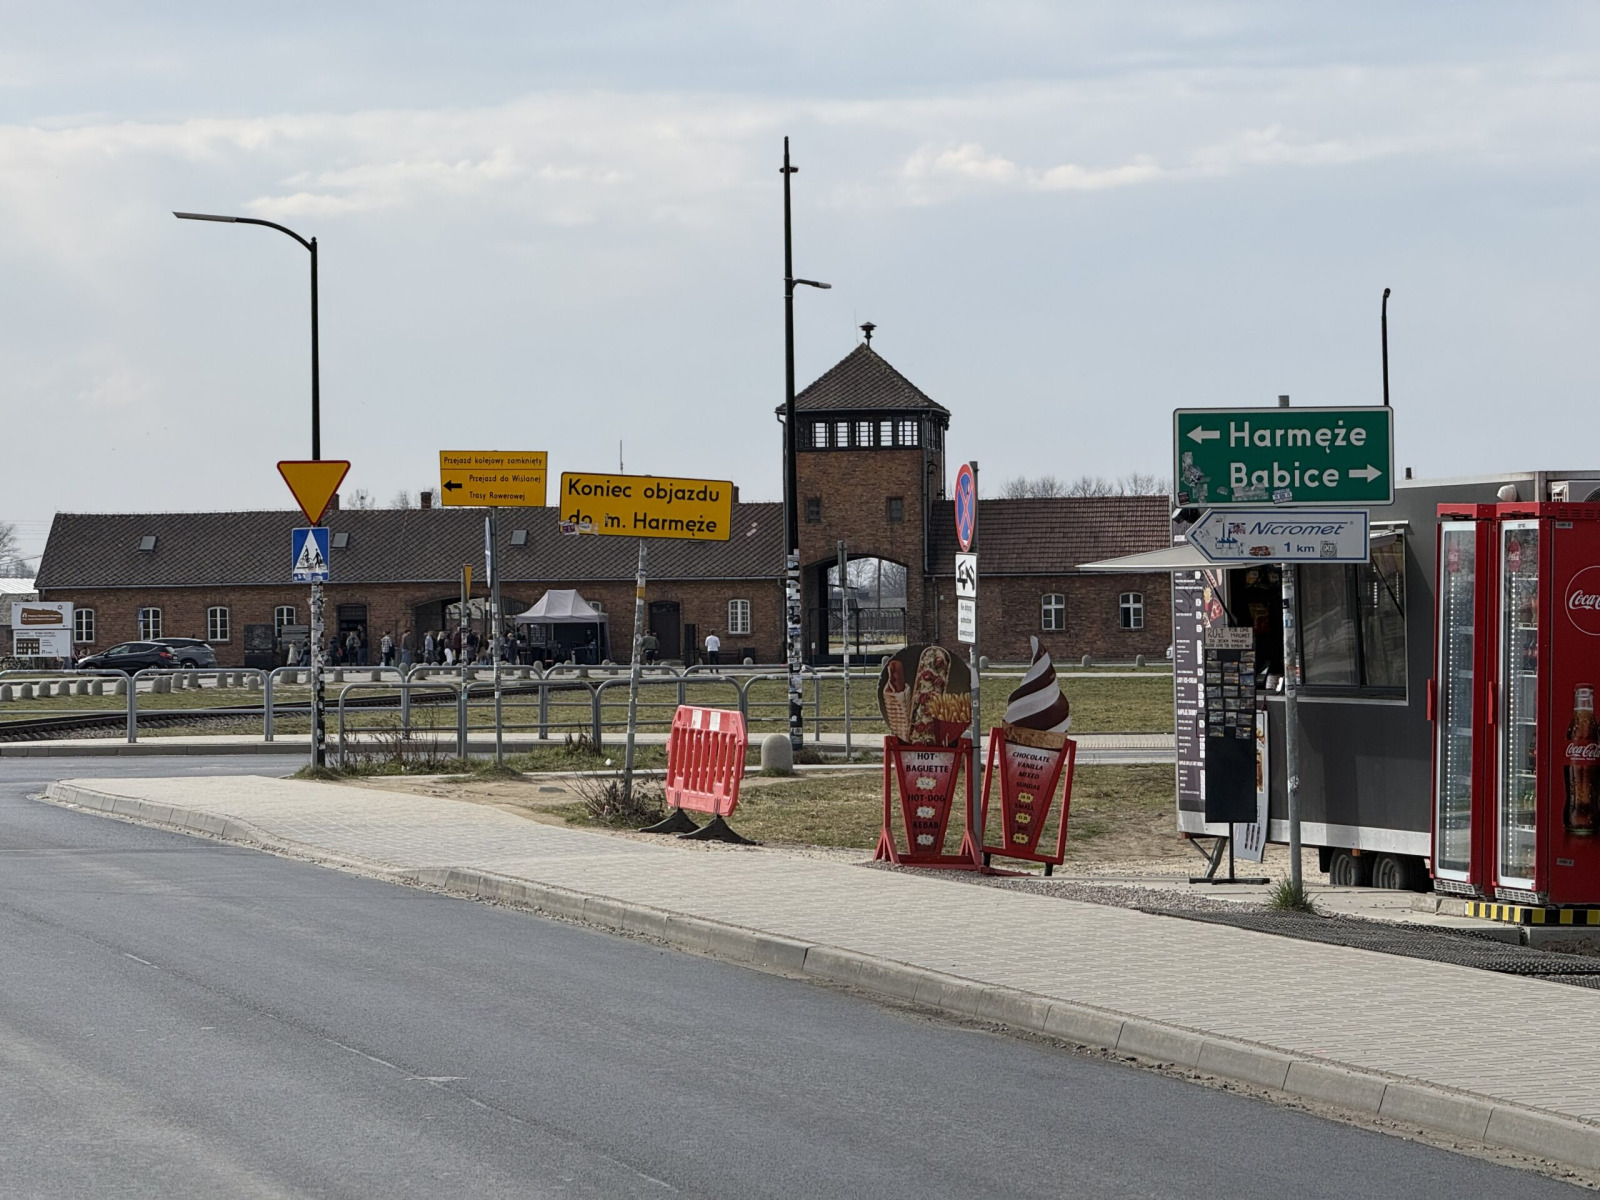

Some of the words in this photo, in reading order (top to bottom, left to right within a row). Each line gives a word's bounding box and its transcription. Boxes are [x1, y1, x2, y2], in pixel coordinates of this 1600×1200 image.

[1229, 420, 1367, 454] Harmęże
[443, 457, 472, 466] Przejazd
[474, 457, 504, 466] kolejowy
[507, 457, 543, 466] zamknięty
[469, 474, 497, 483] Przejazd
[1230, 461, 1339, 488] Babice
[469, 491, 486, 500] Trasy
[489, 492, 525, 501] Rowerowej
[568, 478, 632, 498] Koniec
[643, 482, 720, 504] objazdu
[568, 509, 593, 525] do
[604, 513, 626, 528] m.
[633, 511, 717, 537] Harmęże
[1249, 521, 1346, 536] Nicromet
[1284, 542, 1291, 553] 1
[1296, 543, 1315, 553] km
[917, 752, 938, 760] HOT-
[1012, 751, 1051, 763] CHOCOLATE
[906, 764, 949, 773] BAGUETTE
[1017, 761, 1043, 771] VANILLA
[1018, 771, 1040, 779] MIXED
[907, 794, 946, 802] HOT-DOG
